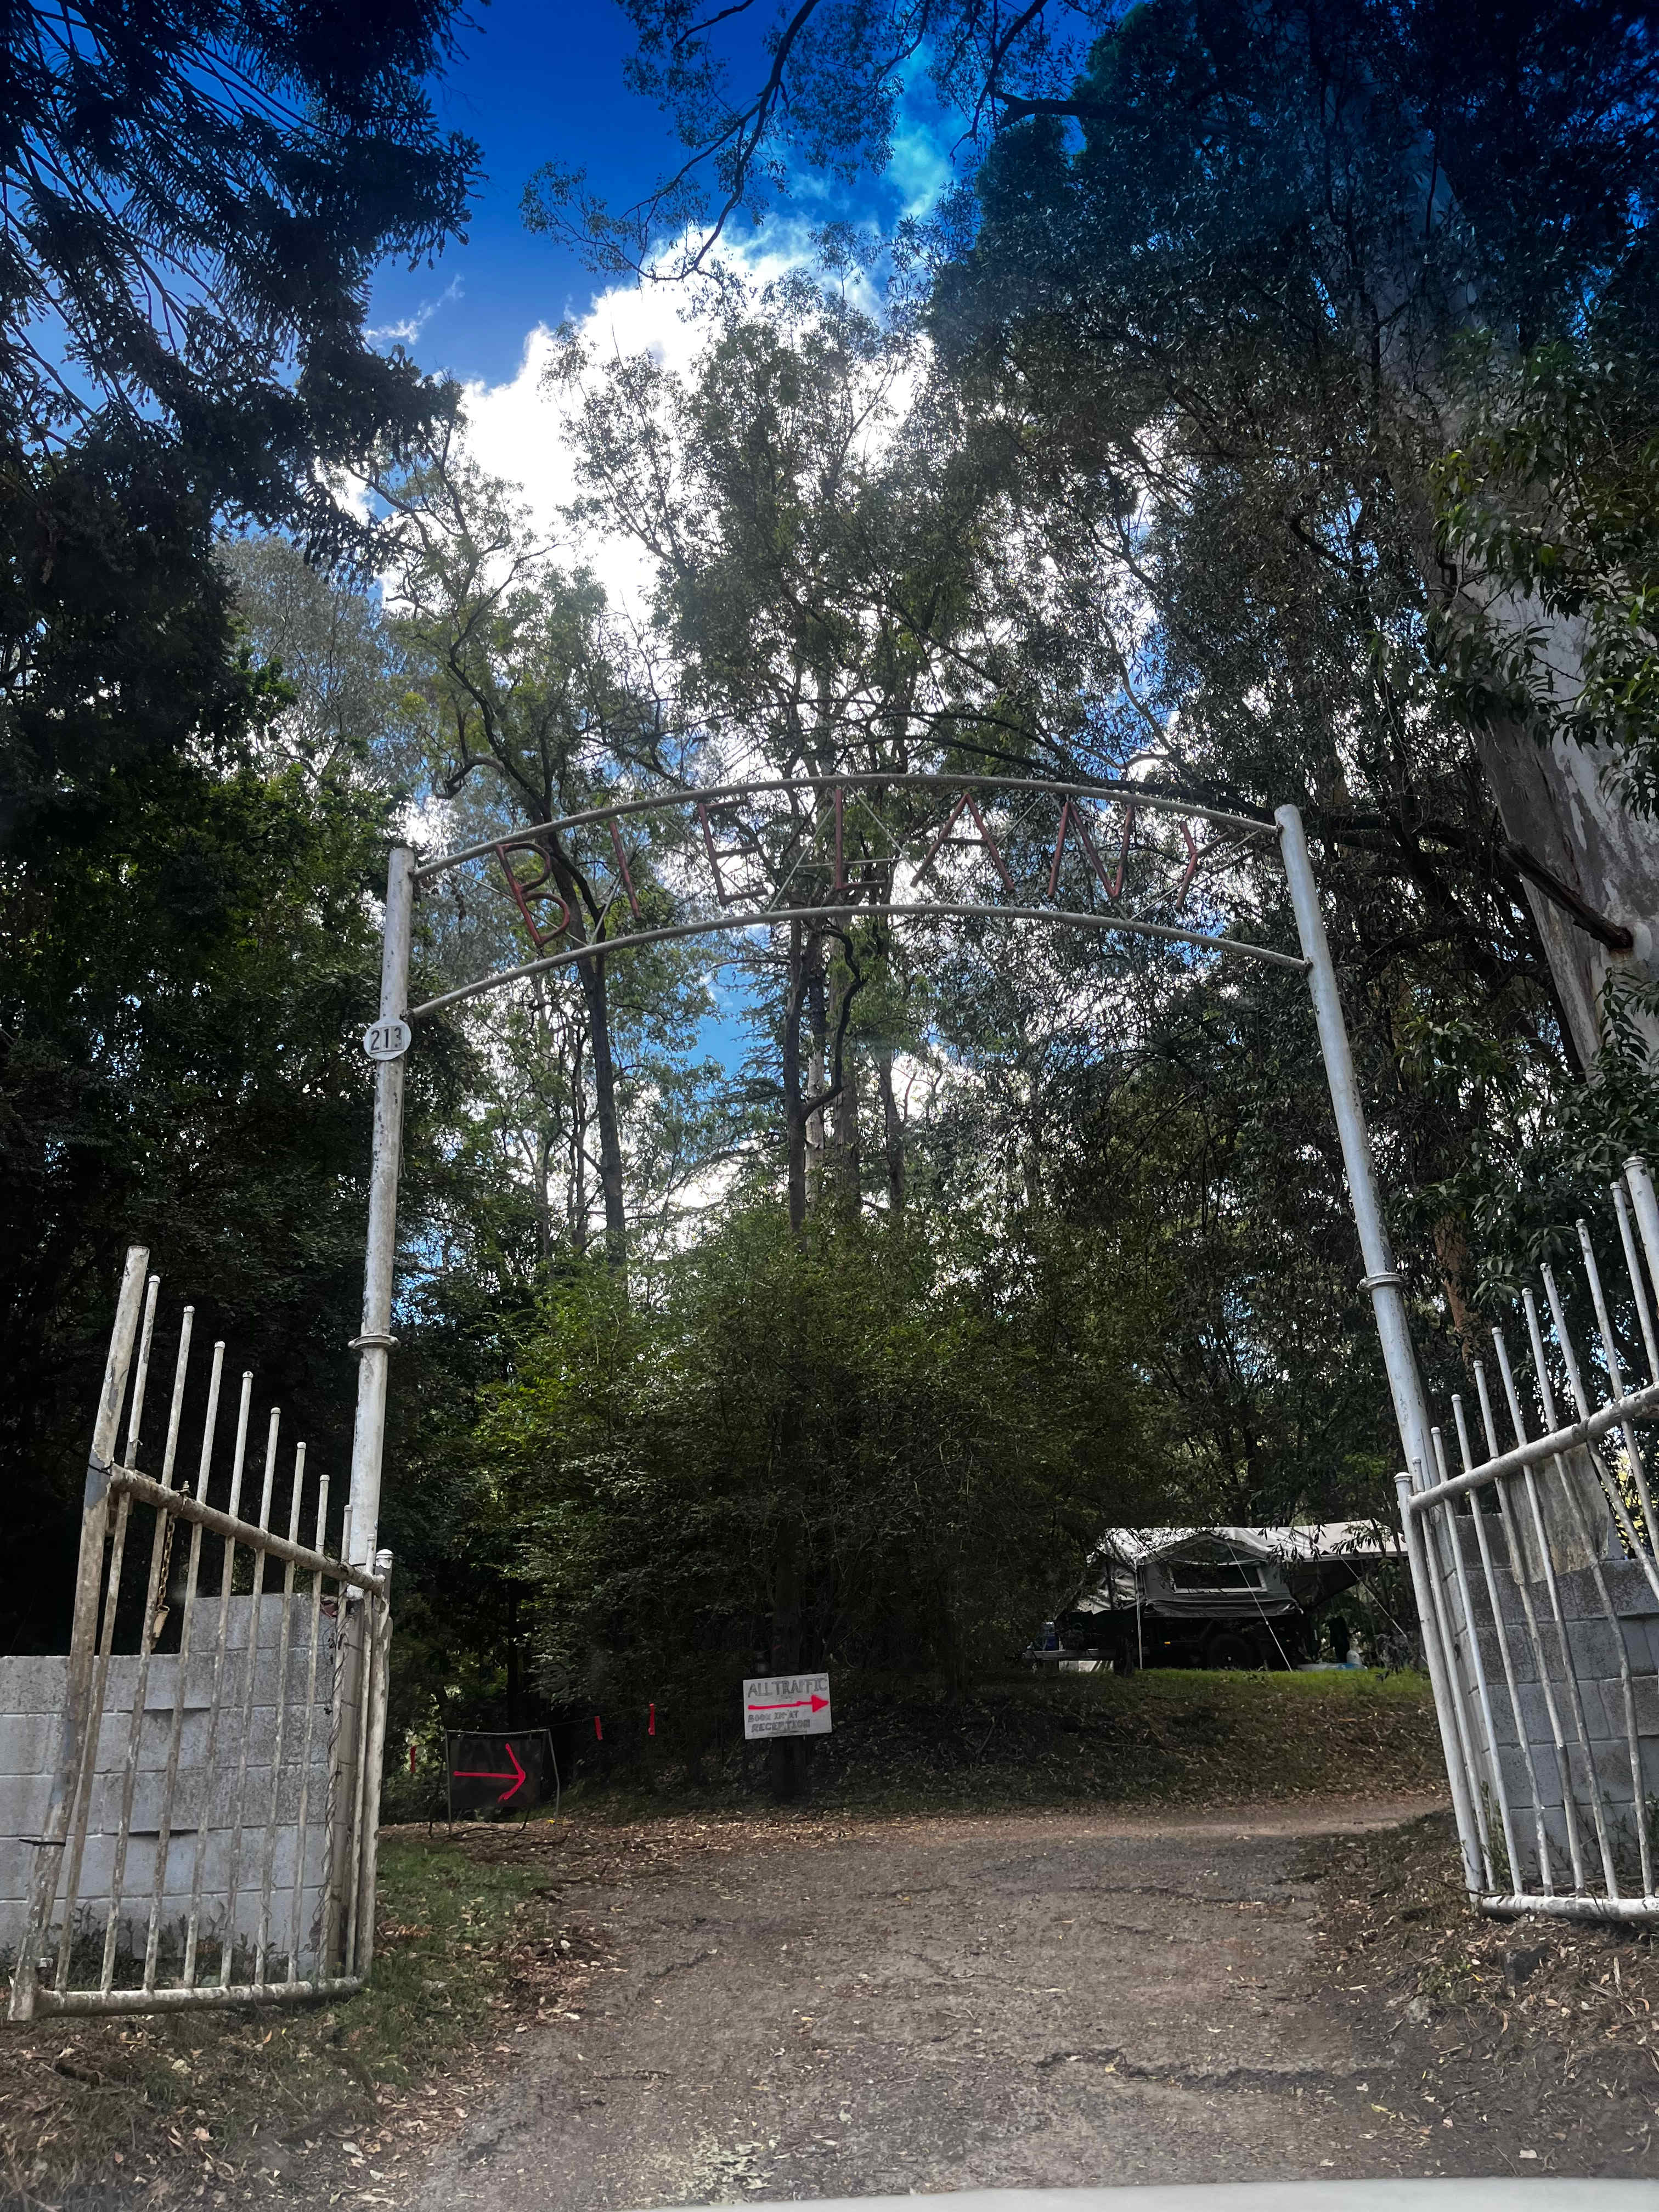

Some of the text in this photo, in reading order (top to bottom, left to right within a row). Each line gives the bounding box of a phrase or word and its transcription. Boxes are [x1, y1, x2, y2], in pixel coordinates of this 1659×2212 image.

[496, 788, 1232, 946] BIELANY
[371, 1027, 402, 1051] 213
[748, 1678, 827, 1697] ALL TRAFFIC
[751, 1719, 810, 1733] RECEPTION
